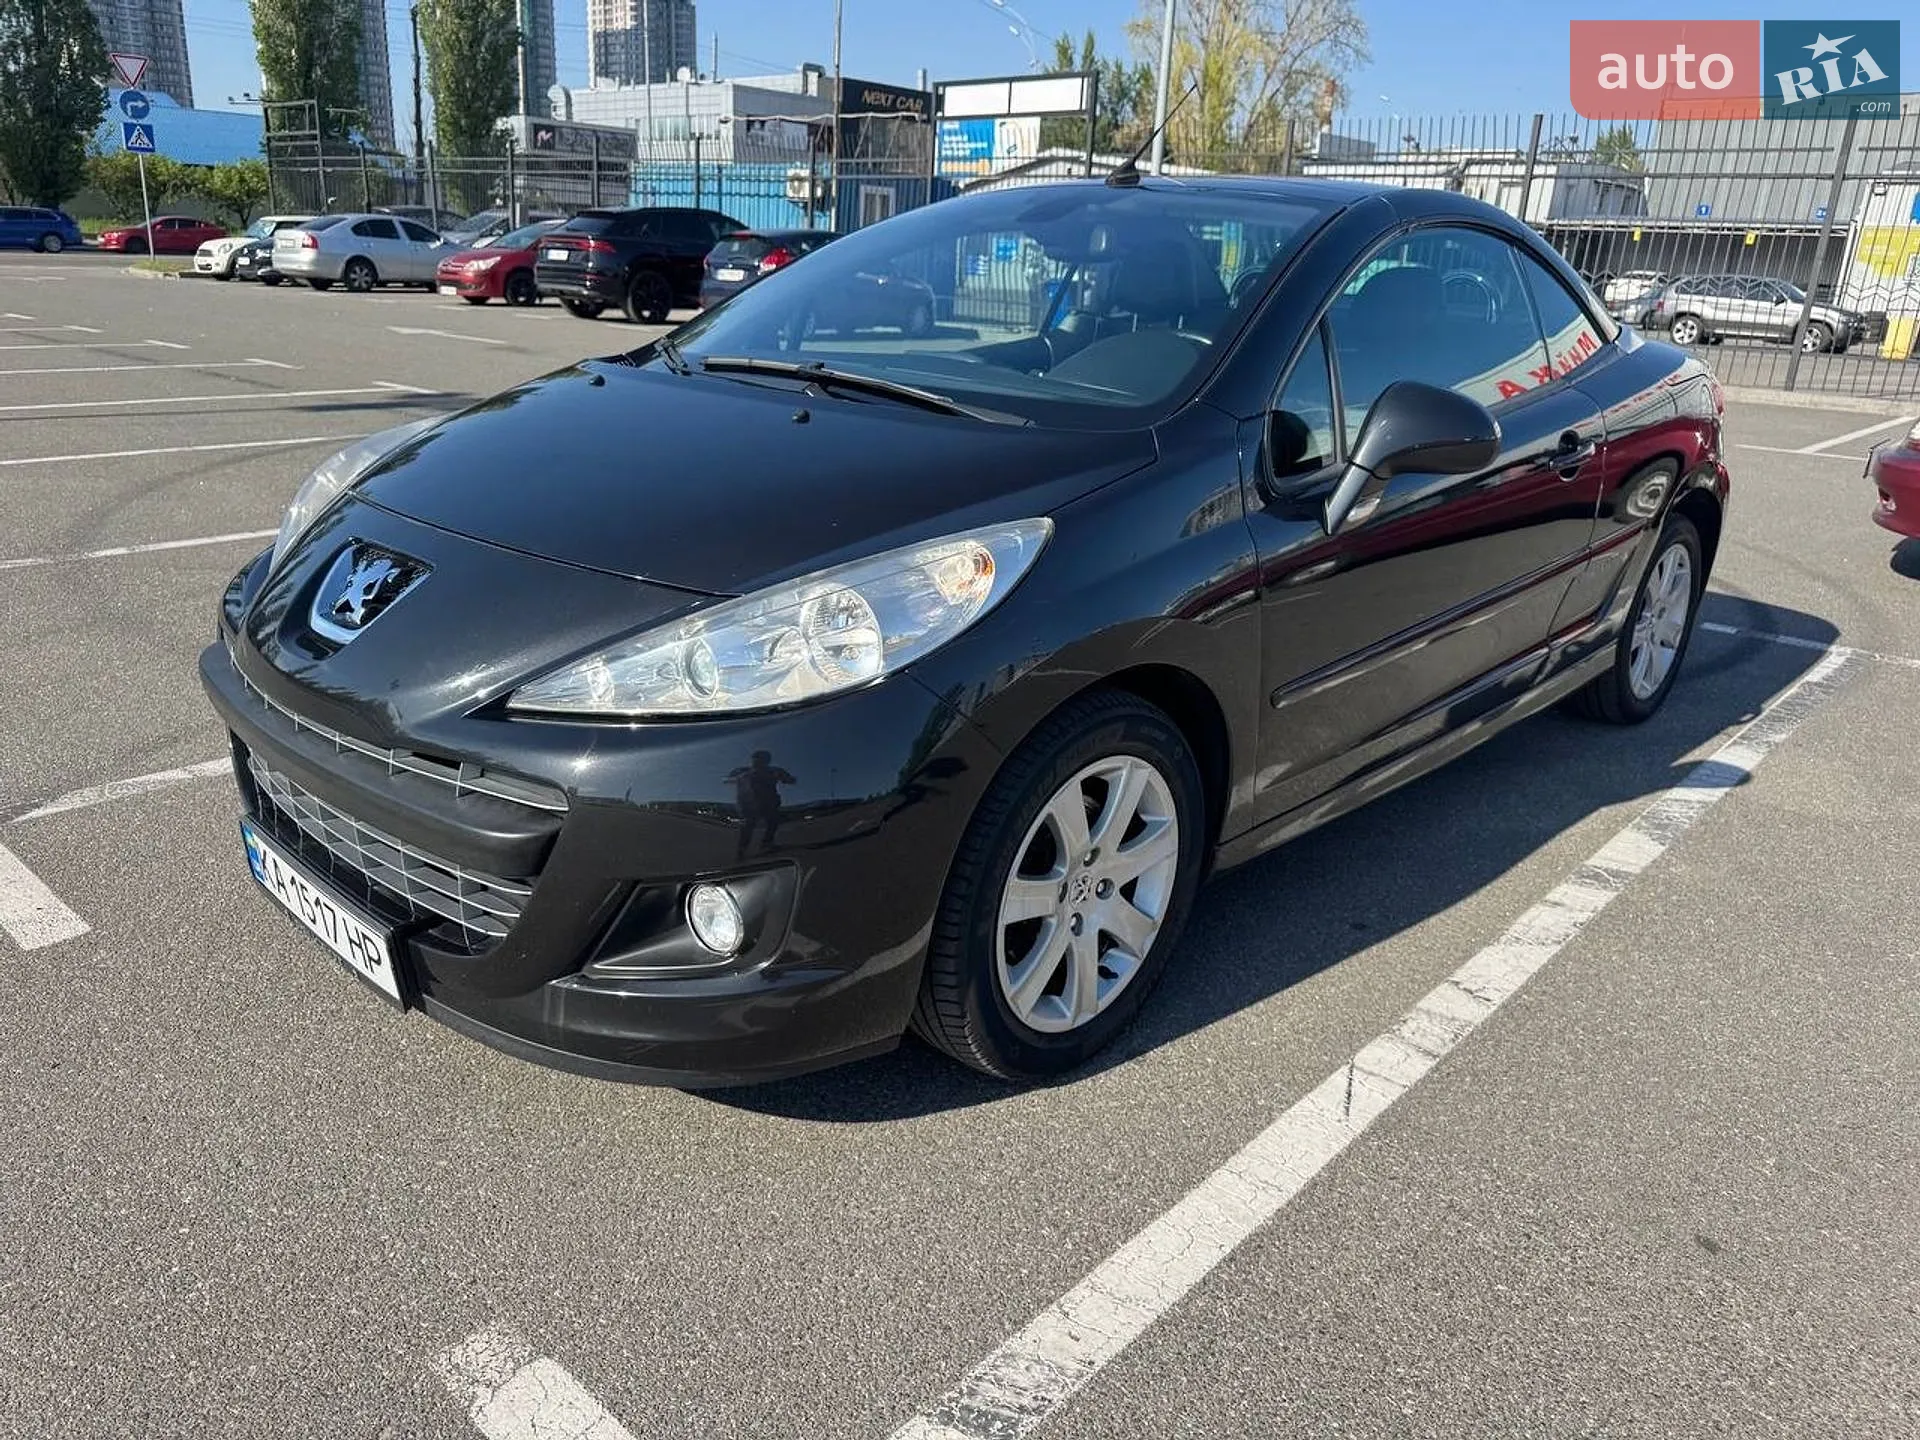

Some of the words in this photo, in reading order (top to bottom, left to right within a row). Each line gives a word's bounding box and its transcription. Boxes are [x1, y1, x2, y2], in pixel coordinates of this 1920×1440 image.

[862, 89, 896, 107] NEXT
[896, 95, 924, 111] CAR
[262, 850, 291, 903] KA
[290, 875, 338, 944] 1517
[342, 917, 383, 974] HP
